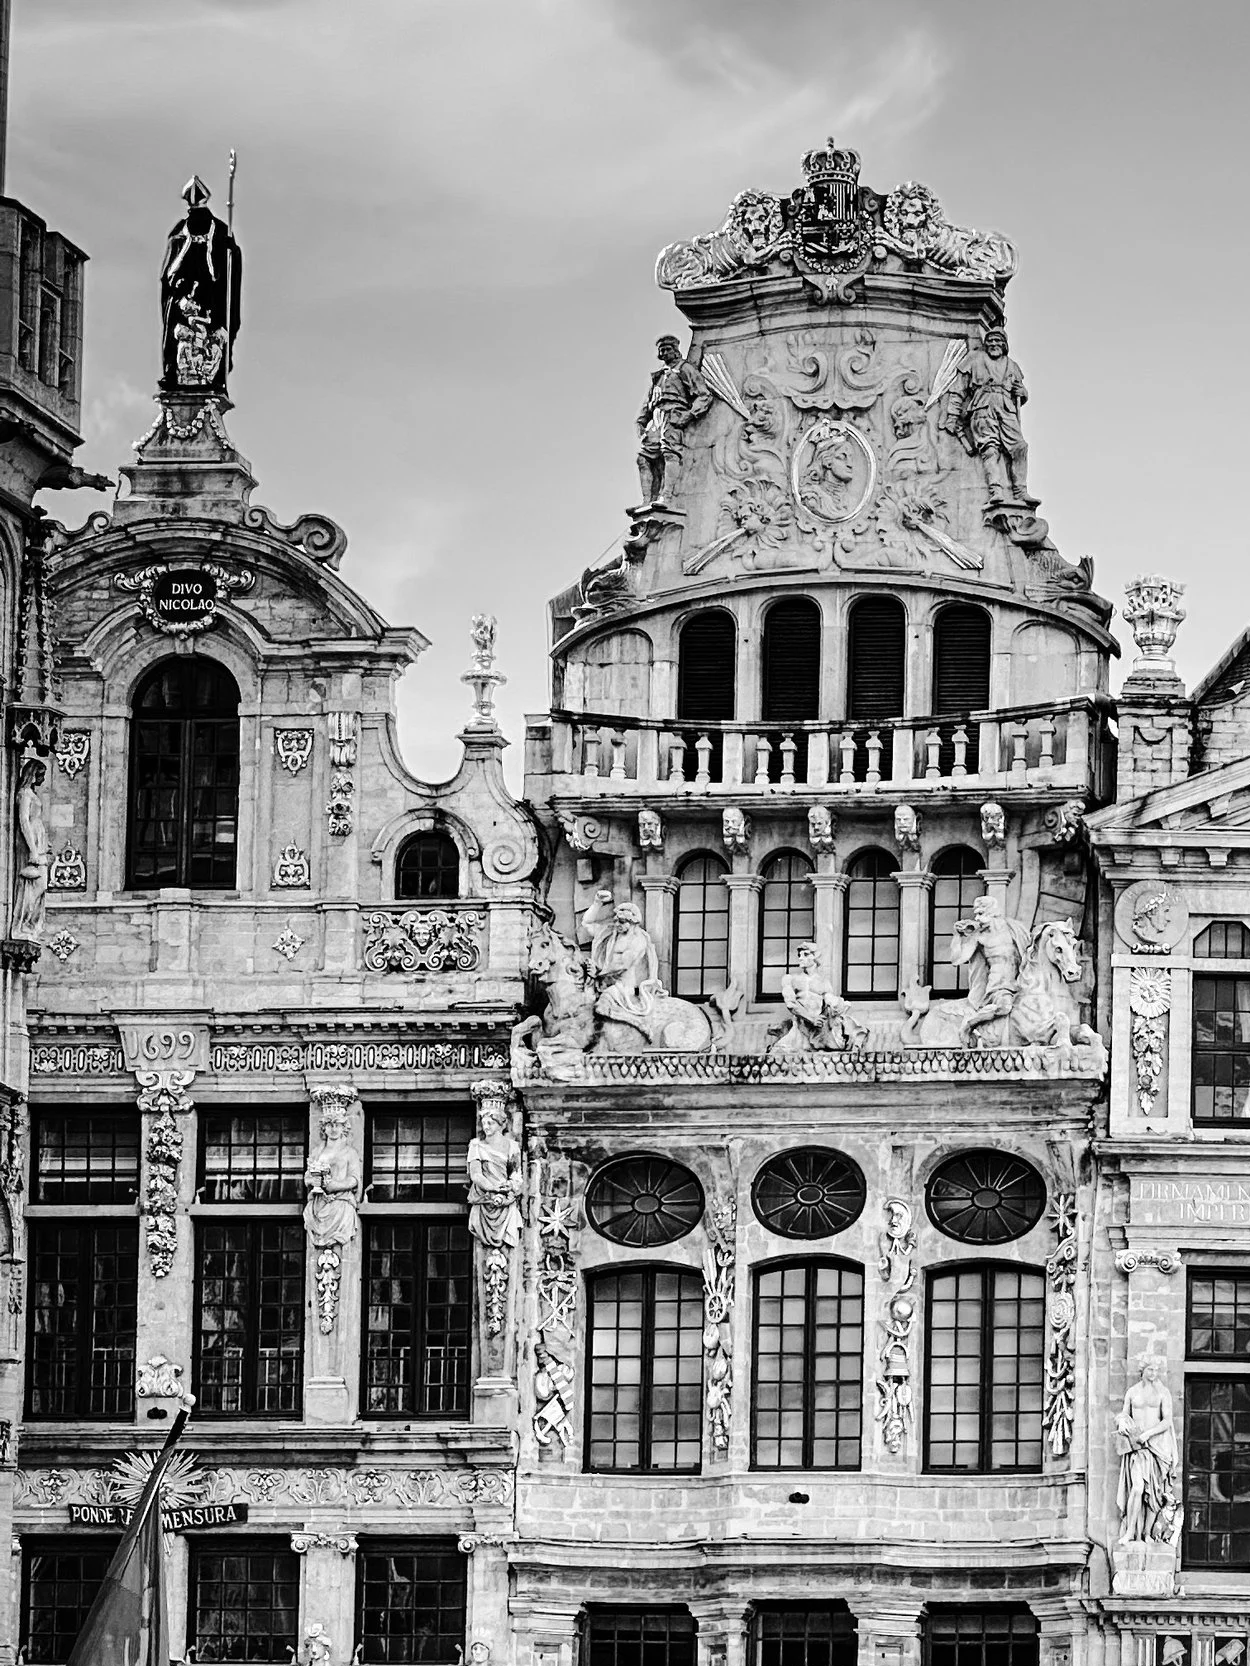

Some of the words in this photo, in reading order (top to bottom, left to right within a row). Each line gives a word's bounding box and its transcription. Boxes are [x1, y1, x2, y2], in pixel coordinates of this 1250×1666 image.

[172, 583, 202, 595] DIVO
[159, 599, 214, 611] NICOLAO
[128, 1029, 197, 1061] 1699
[160, 1505, 238, 1530] MENSURA
